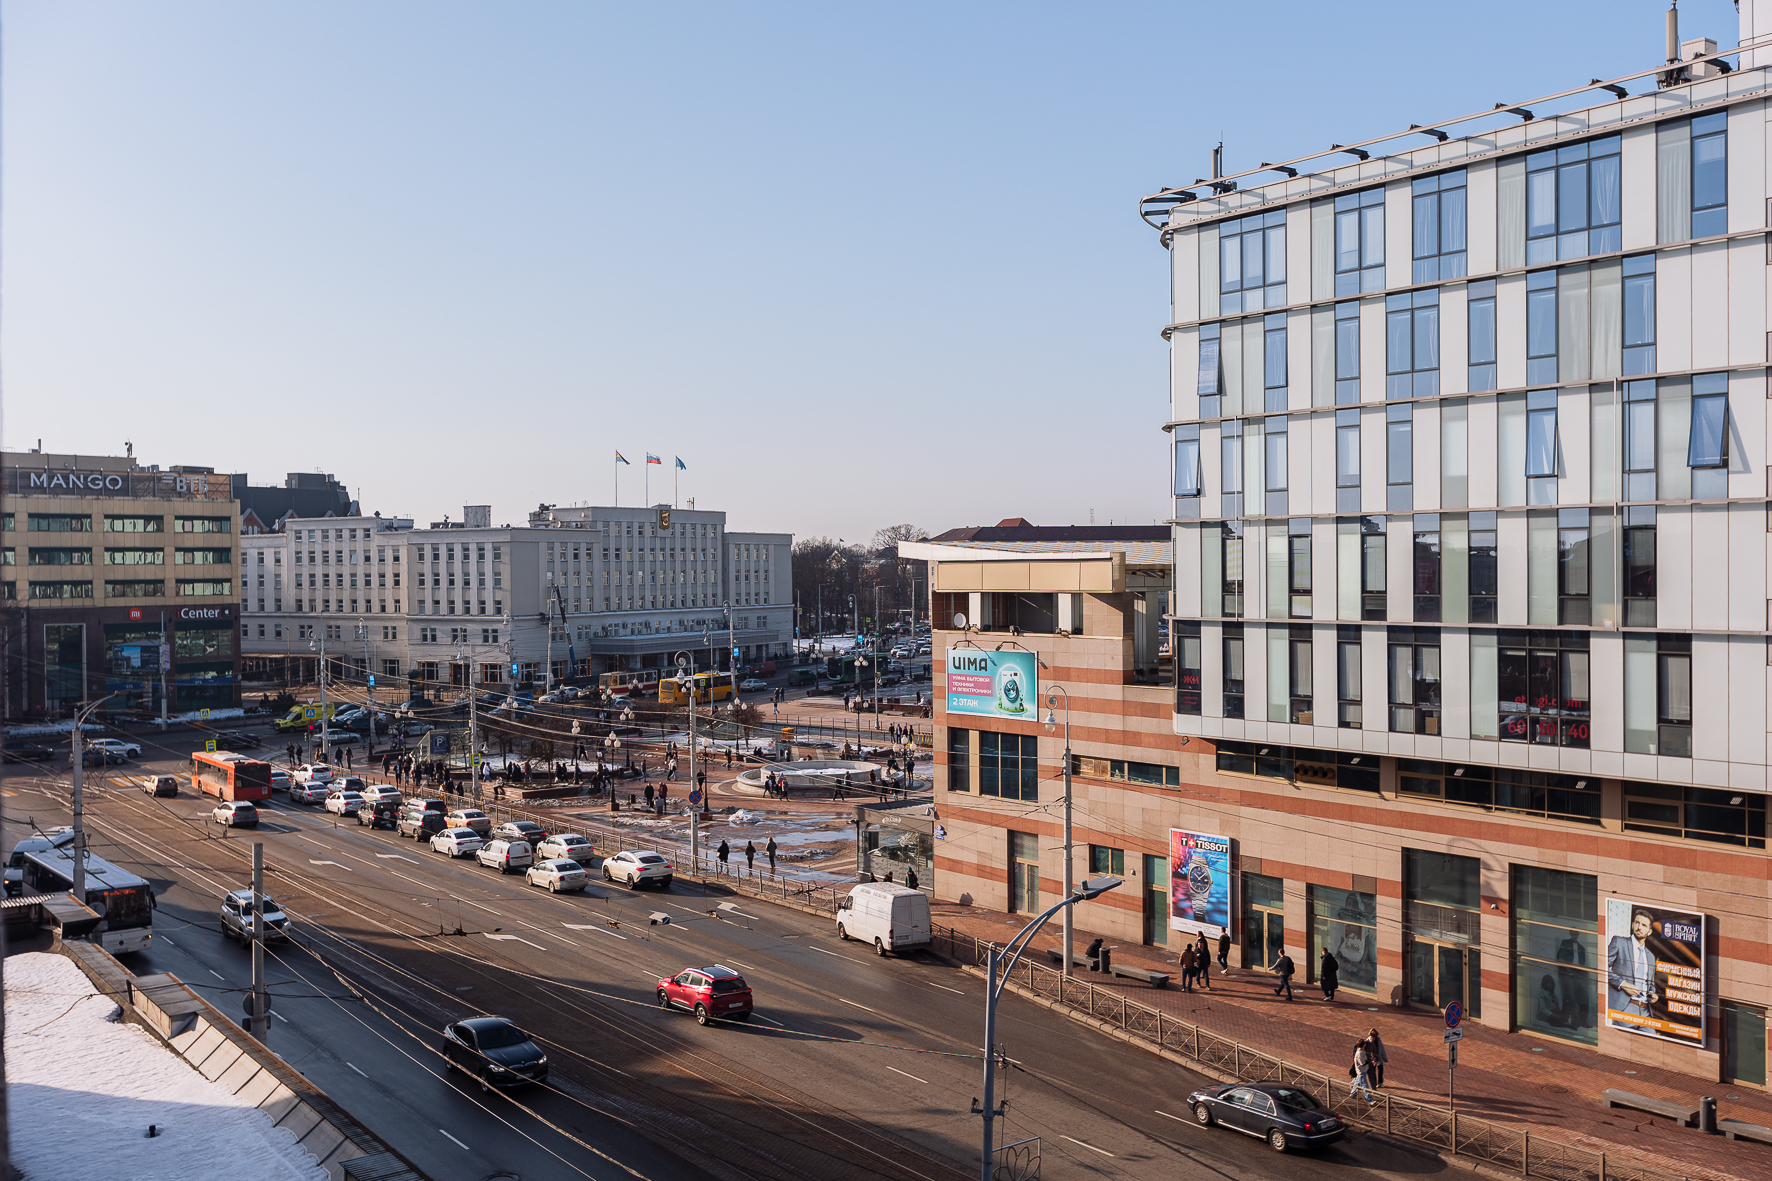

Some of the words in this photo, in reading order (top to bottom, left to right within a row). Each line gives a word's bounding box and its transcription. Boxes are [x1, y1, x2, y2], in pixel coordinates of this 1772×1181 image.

[30, 472, 123, 490] MANGO
[176, 476, 209, 493] ВТБ
[177, 607, 220, 619] iCenter
[952, 697, 958, 706] 2
[958, 697, 979, 707] ЭТАЖ
[1507, 719, 1526, 734] 60
[1538, 721, 1556, 737] 50
[1568, 723, 1588, 739] 40
[1196, 840, 1228, 853] TISSOT
[1674, 931, 1698, 942] SPIRIT
[1675, 924, 1697, 935] ROYAL
[1657, 963, 1701, 979] ФИРМЕННЫЙ
[1669, 977, 1701, 991] МАГАЗИН
[1666, 989, 1701, 1004] МУЖСКОЙ
[1669, 1002, 1701, 1016] ОДЕЖДЫ
